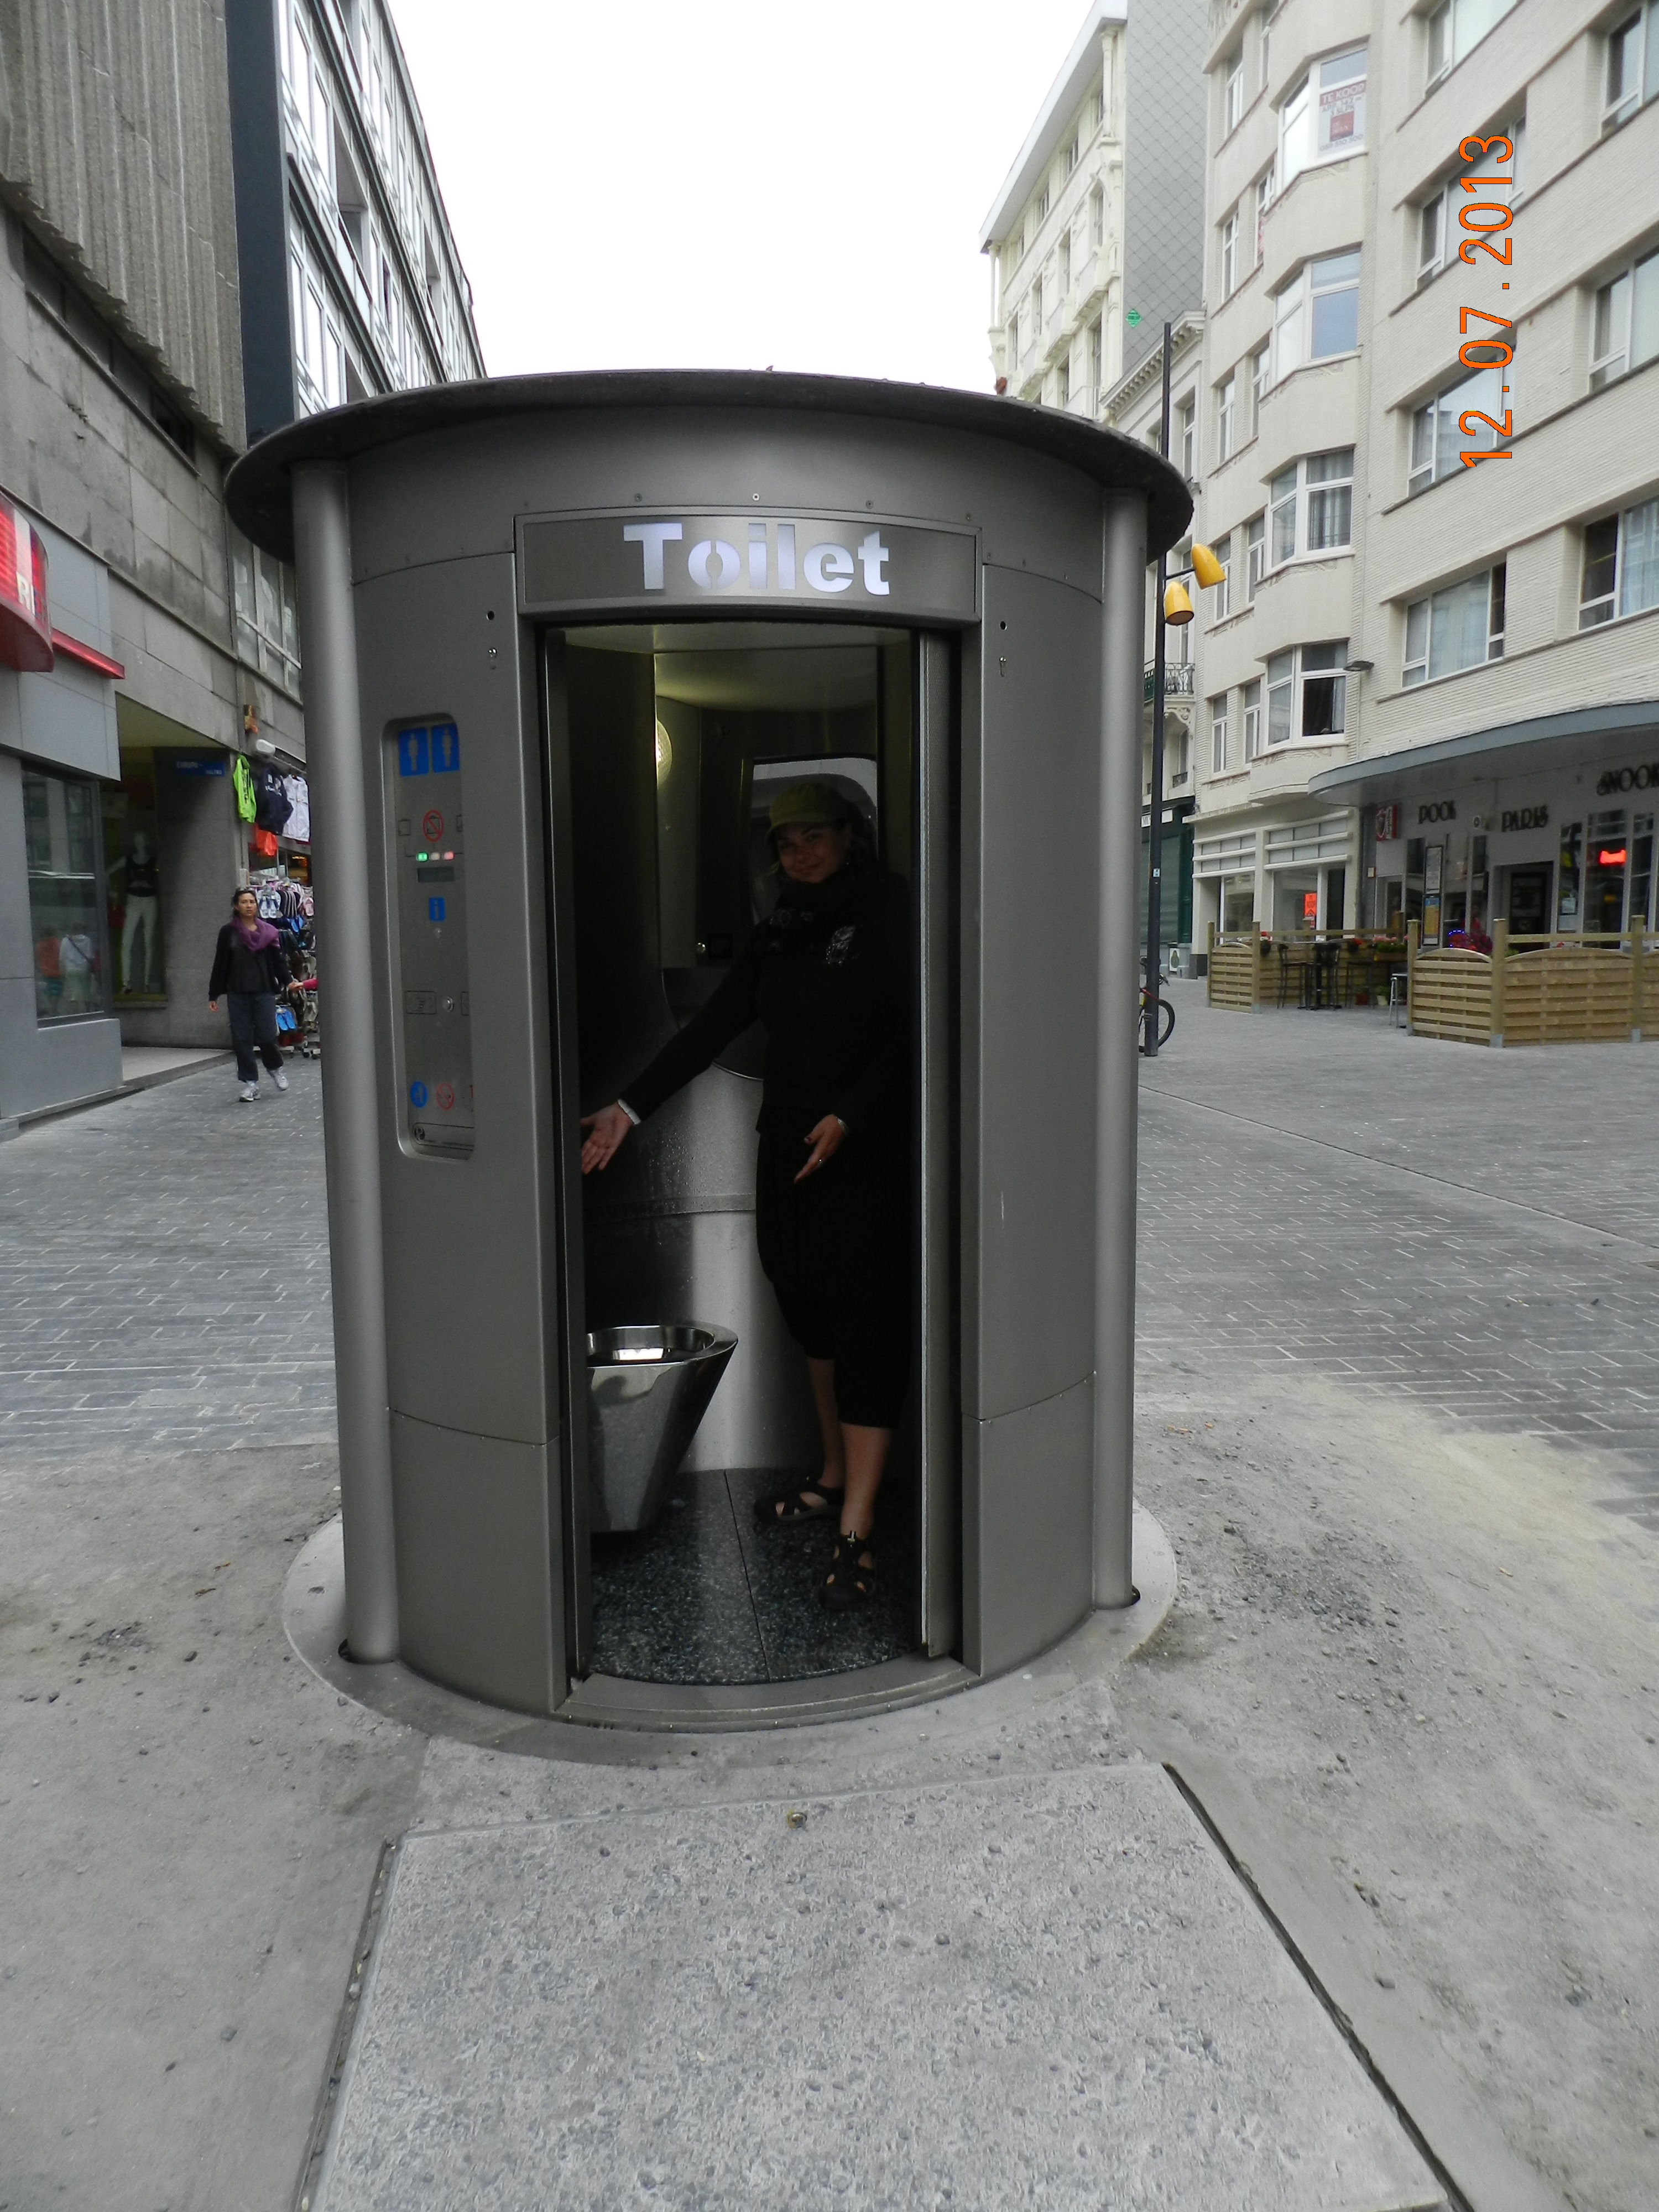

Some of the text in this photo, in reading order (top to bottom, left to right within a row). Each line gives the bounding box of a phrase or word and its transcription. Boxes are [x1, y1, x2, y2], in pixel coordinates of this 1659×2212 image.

[1322, 84, 1365, 103] TE KOOP
[623, 521, 890, 596] Toilet
[1501, 804, 1548, 832] PARIS
